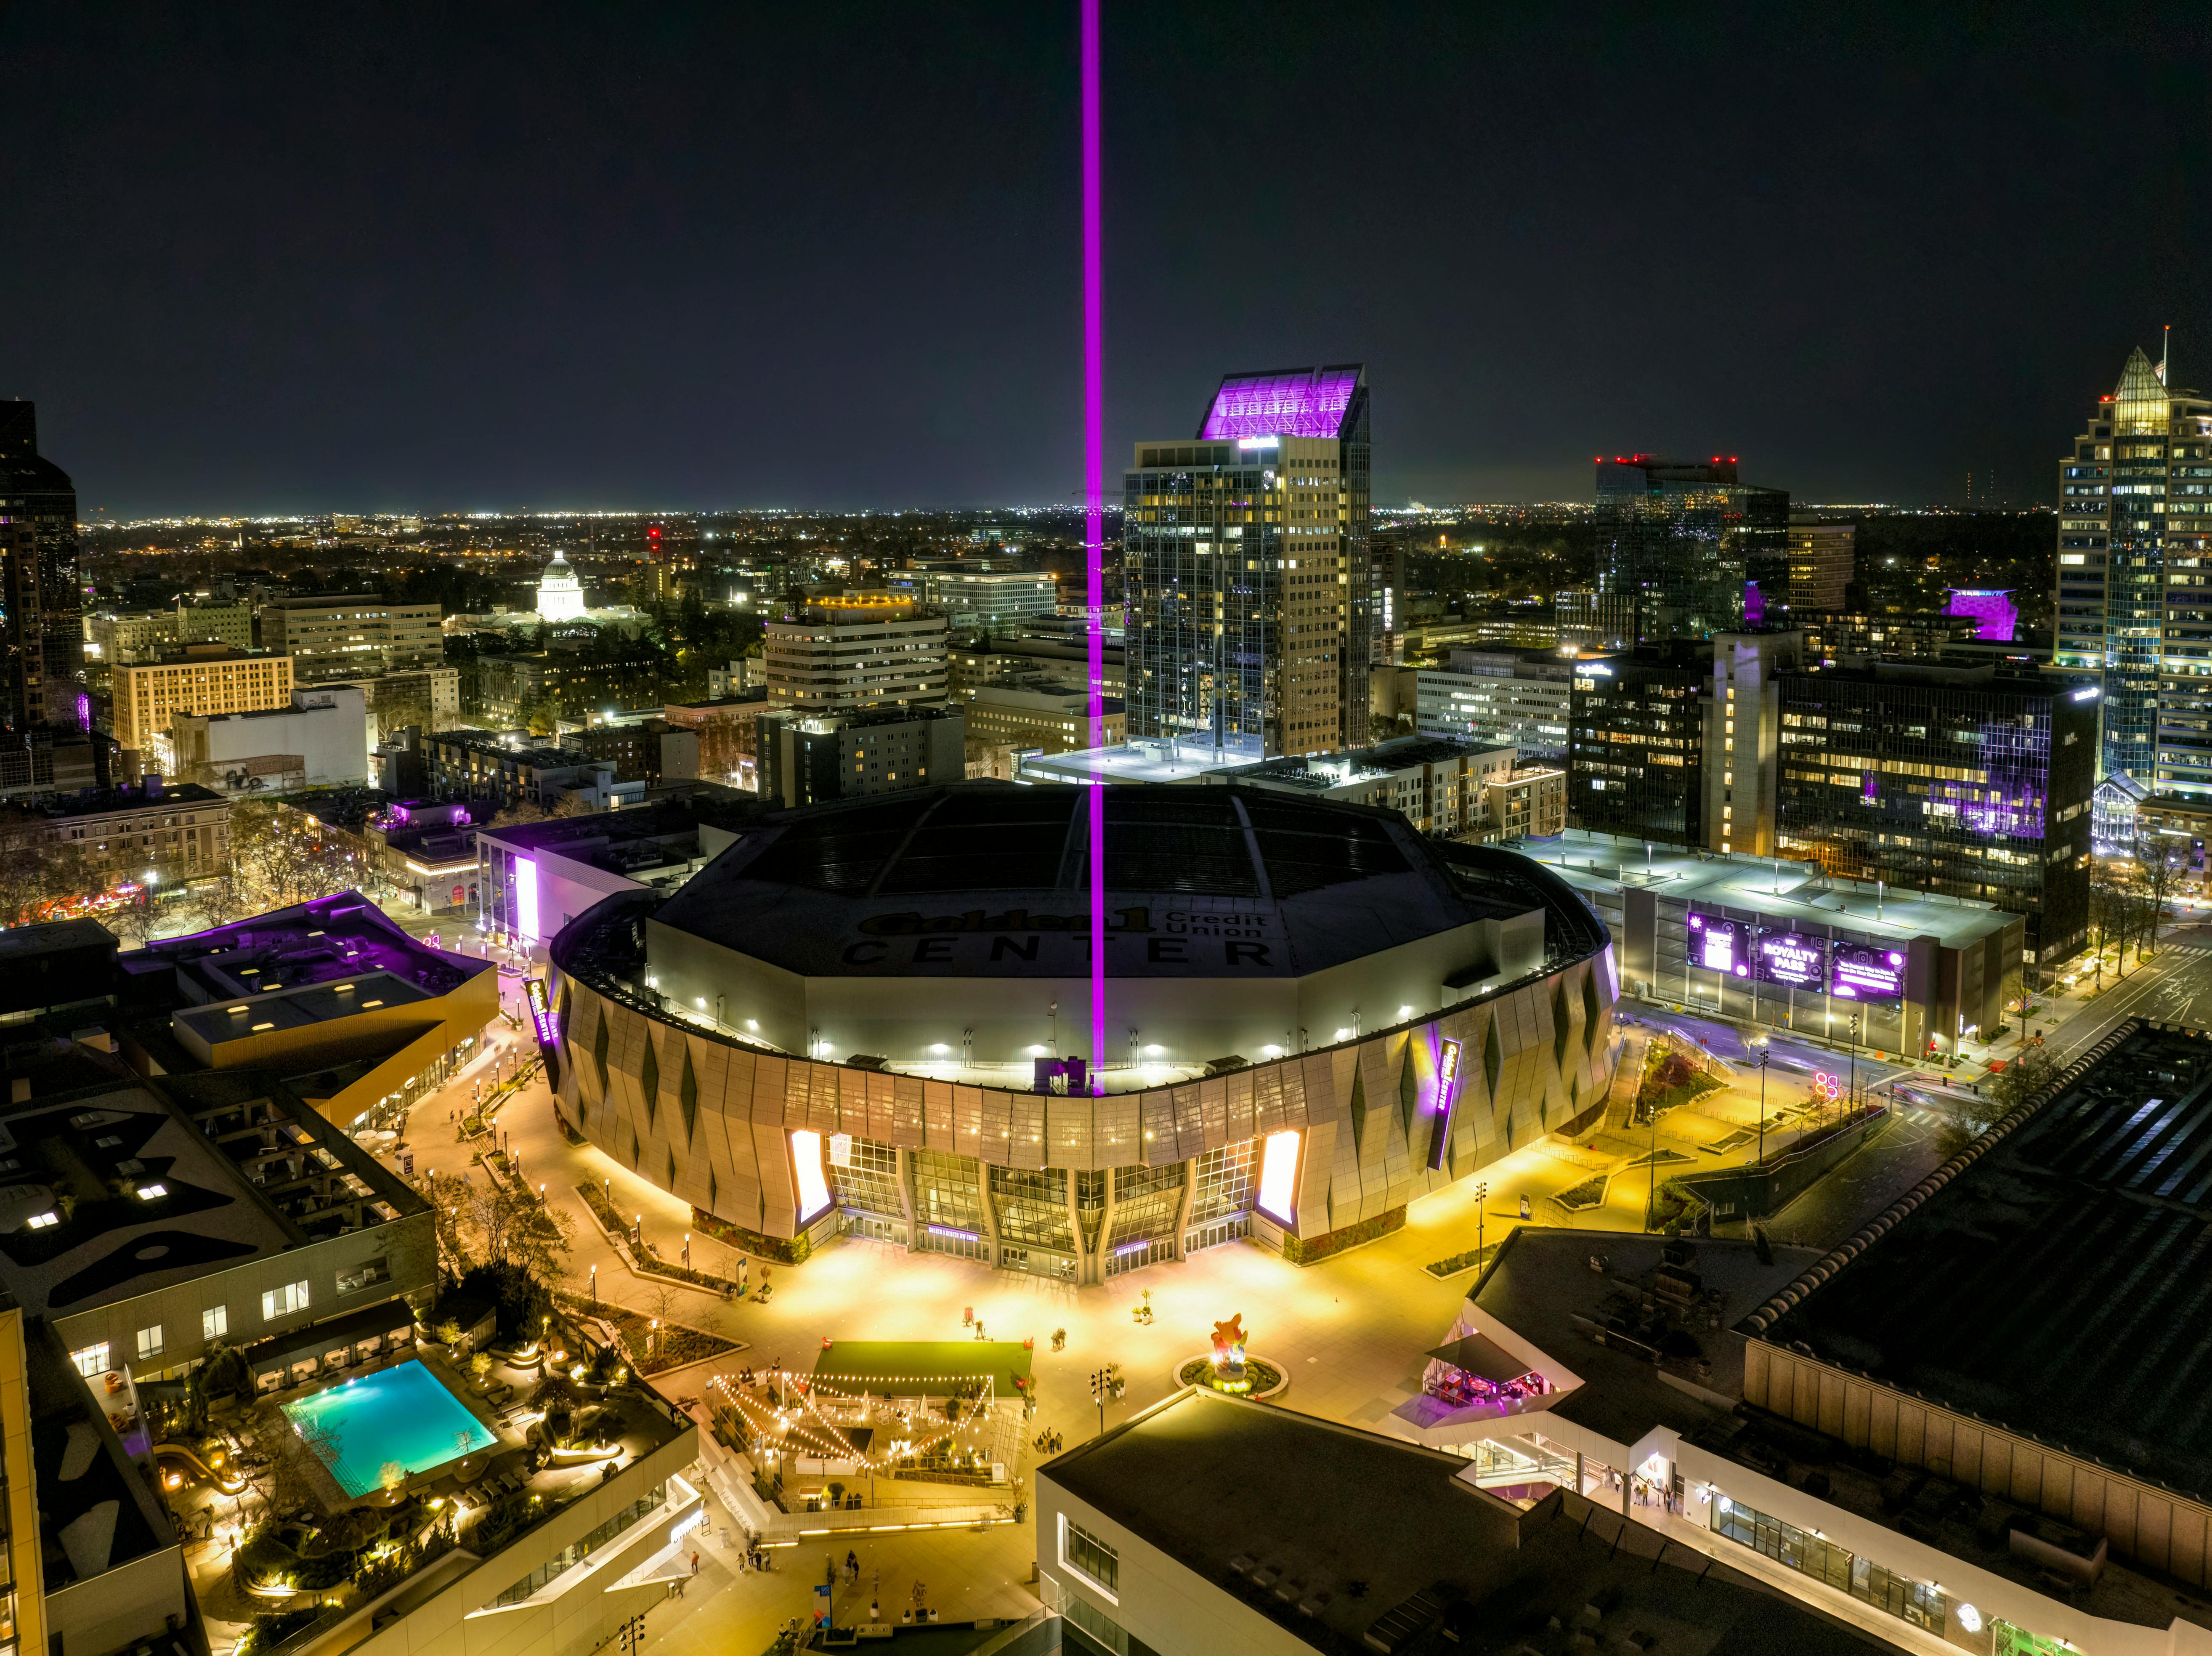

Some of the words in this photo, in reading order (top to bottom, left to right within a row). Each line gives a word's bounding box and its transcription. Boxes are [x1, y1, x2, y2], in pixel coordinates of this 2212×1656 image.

[1166, 912, 1267, 927] Credit
[1166, 923, 1262, 937] Union
[841, 935, 1274, 968] CENTER
[1764, 943, 1818, 963] ROYALTY
[1775, 957, 1806, 972] PASS
[538, 1013, 551, 1042] CENTER
[1438, 1079, 1449, 1110] CENTER
[928, 1226, 943, 1235] GOLDEN
[945, 1230, 959, 1239] CENTER
[1116, 1247, 1131, 1256] GOLDEN
[1133, 1242, 1147, 1252] CENTER
